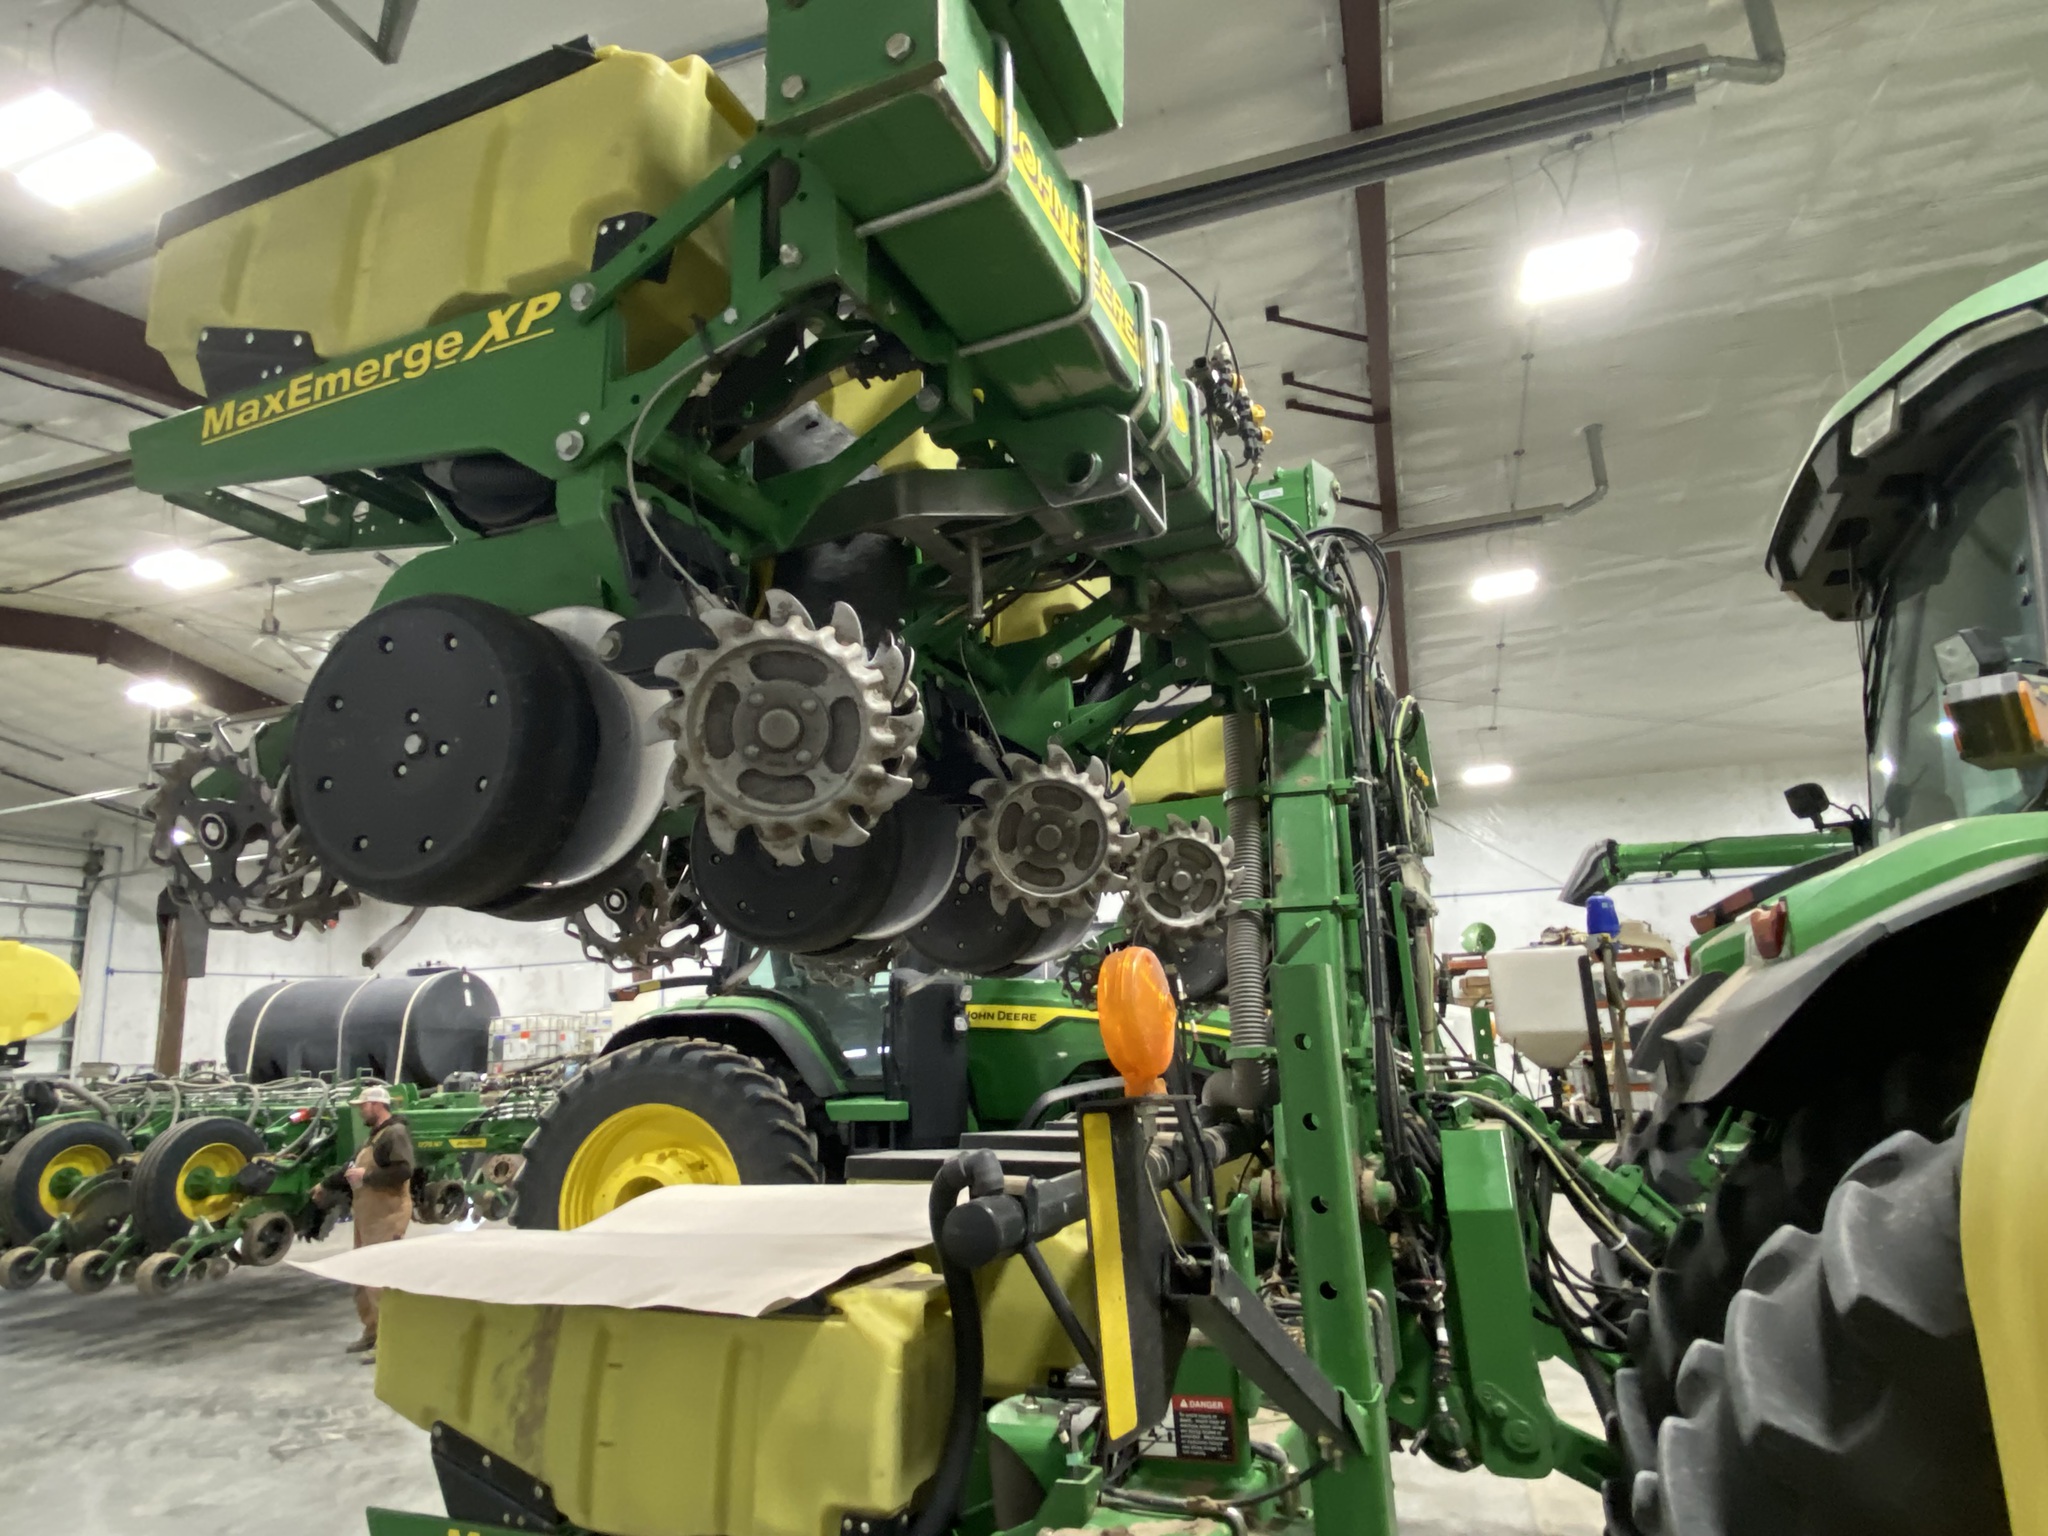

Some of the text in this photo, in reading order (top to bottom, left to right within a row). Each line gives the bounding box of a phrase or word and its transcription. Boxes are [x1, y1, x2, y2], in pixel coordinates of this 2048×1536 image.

[202, 291, 562, 438] MaxEmerge XP
[967, 1010, 1037, 1022] JOHN DEERE
[1189, 1400, 1224, 1410] DANGER
